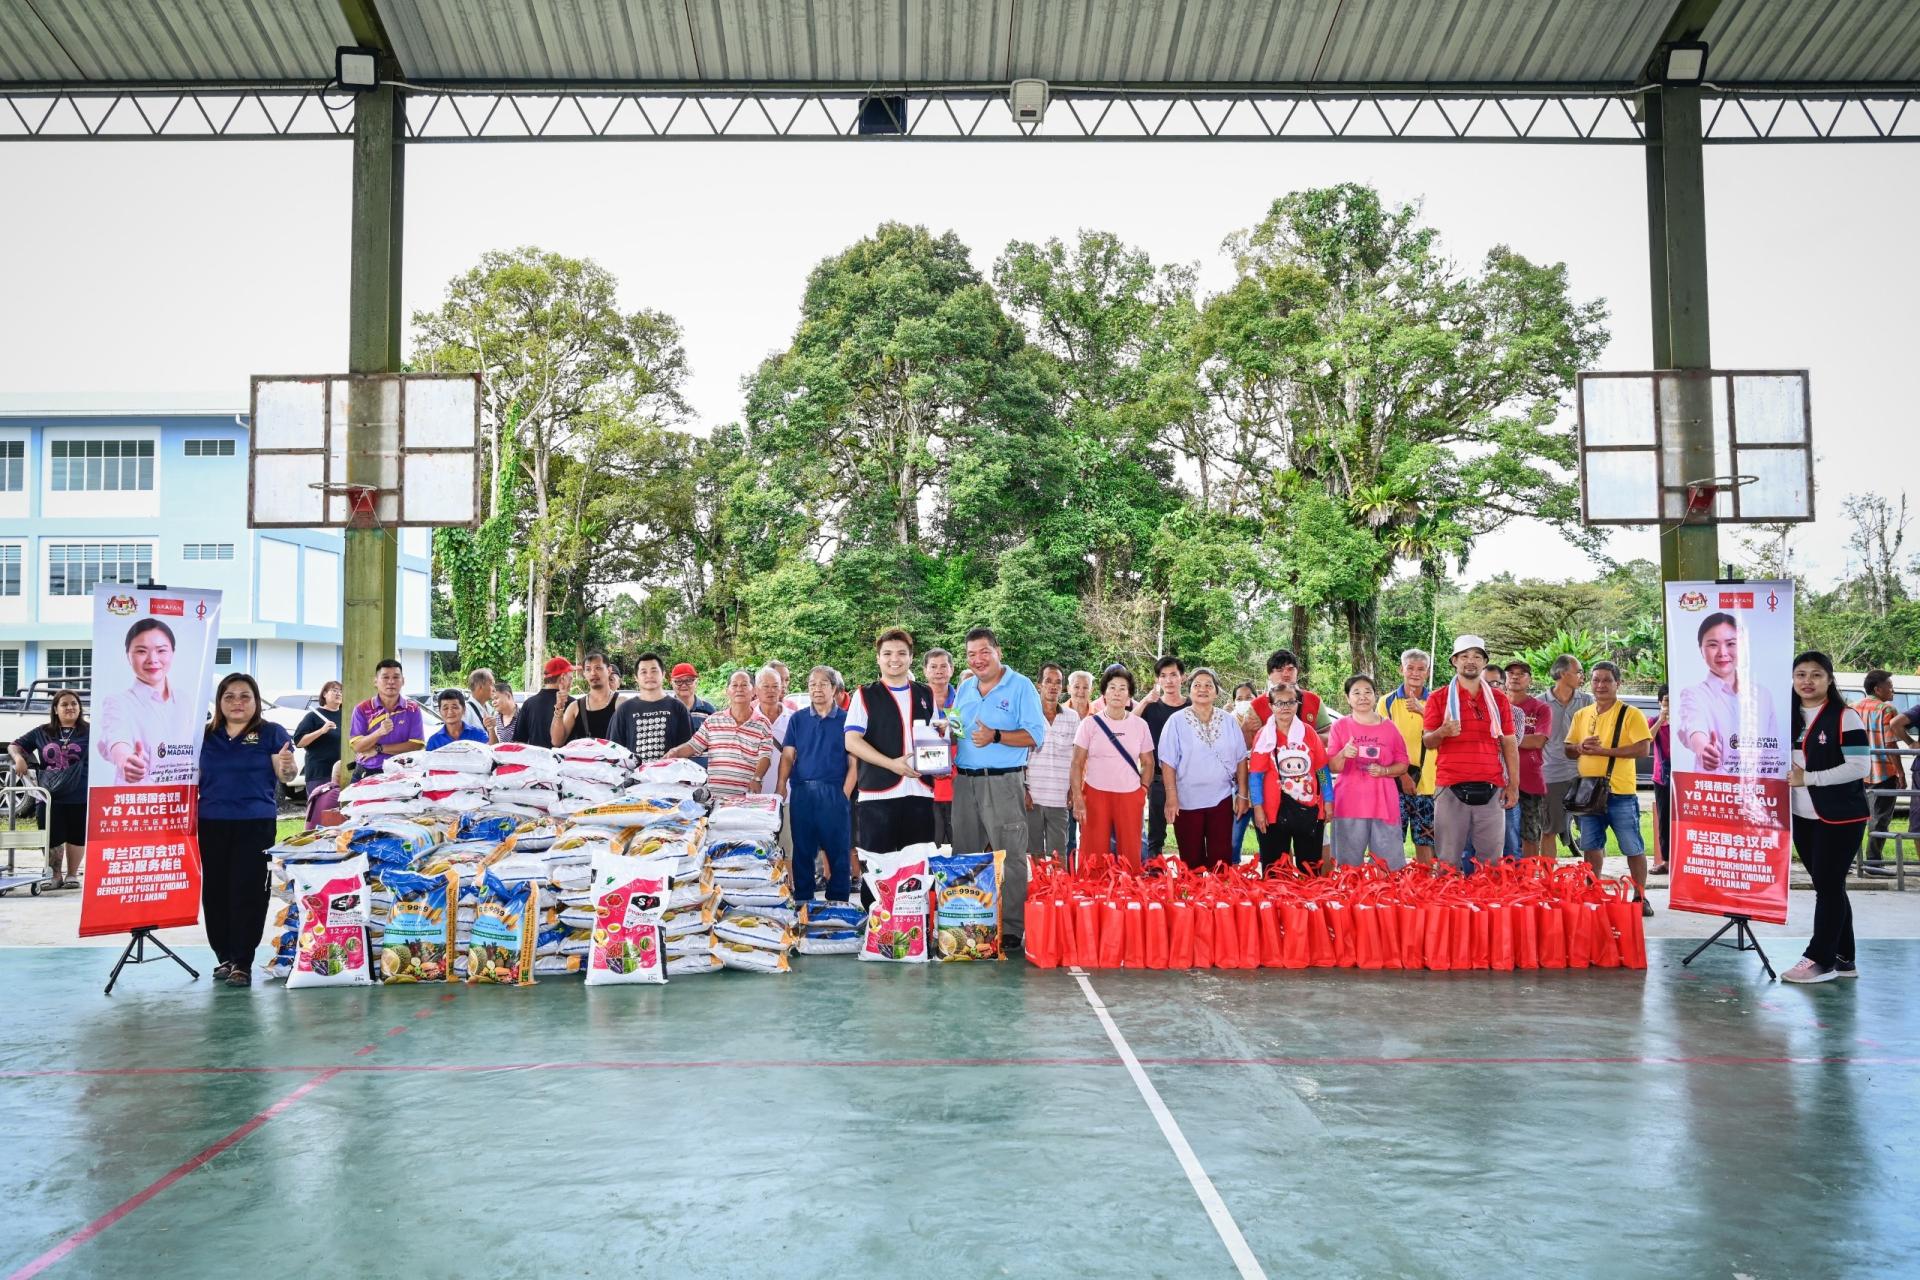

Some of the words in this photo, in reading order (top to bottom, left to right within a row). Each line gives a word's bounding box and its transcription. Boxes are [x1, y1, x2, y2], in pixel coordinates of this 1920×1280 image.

[1684, 790, 1702, 800] YB
[1706, 792, 1743, 804] ALICE
[102, 806, 122, 816] YB
[126, 804, 167, 816] ALICE
[170, 804, 190, 814] LAU
[102, 844, 186, 861] 南兰区国会议员
[1687, 857, 1715, 868] KAUNTER
[1716, 861, 1772, 874] PERKHIDMATAN
[101, 875, 134, 886] KAUNTER
[1683, 865, 1716, 877] BERGERAK
[1717, 870, 1740, 880] PUSAT
[1742, 872, 1776, 884] KHIDMAT
[96, 886, 134, 896] BERGERAK
[135, 883, 158, 894] PUSAT
[160, 880, 190, 891] KHIDMAT
[1704, 877, 1721, 886] P.211
[1722, 880, 1750, 890] LANANG
[120, 894, 139, 904] P.211
[140, 892, 168, 902] LANANG
[959, 888, 980, 897] 9999
[638, 897, 654, 906] S9
